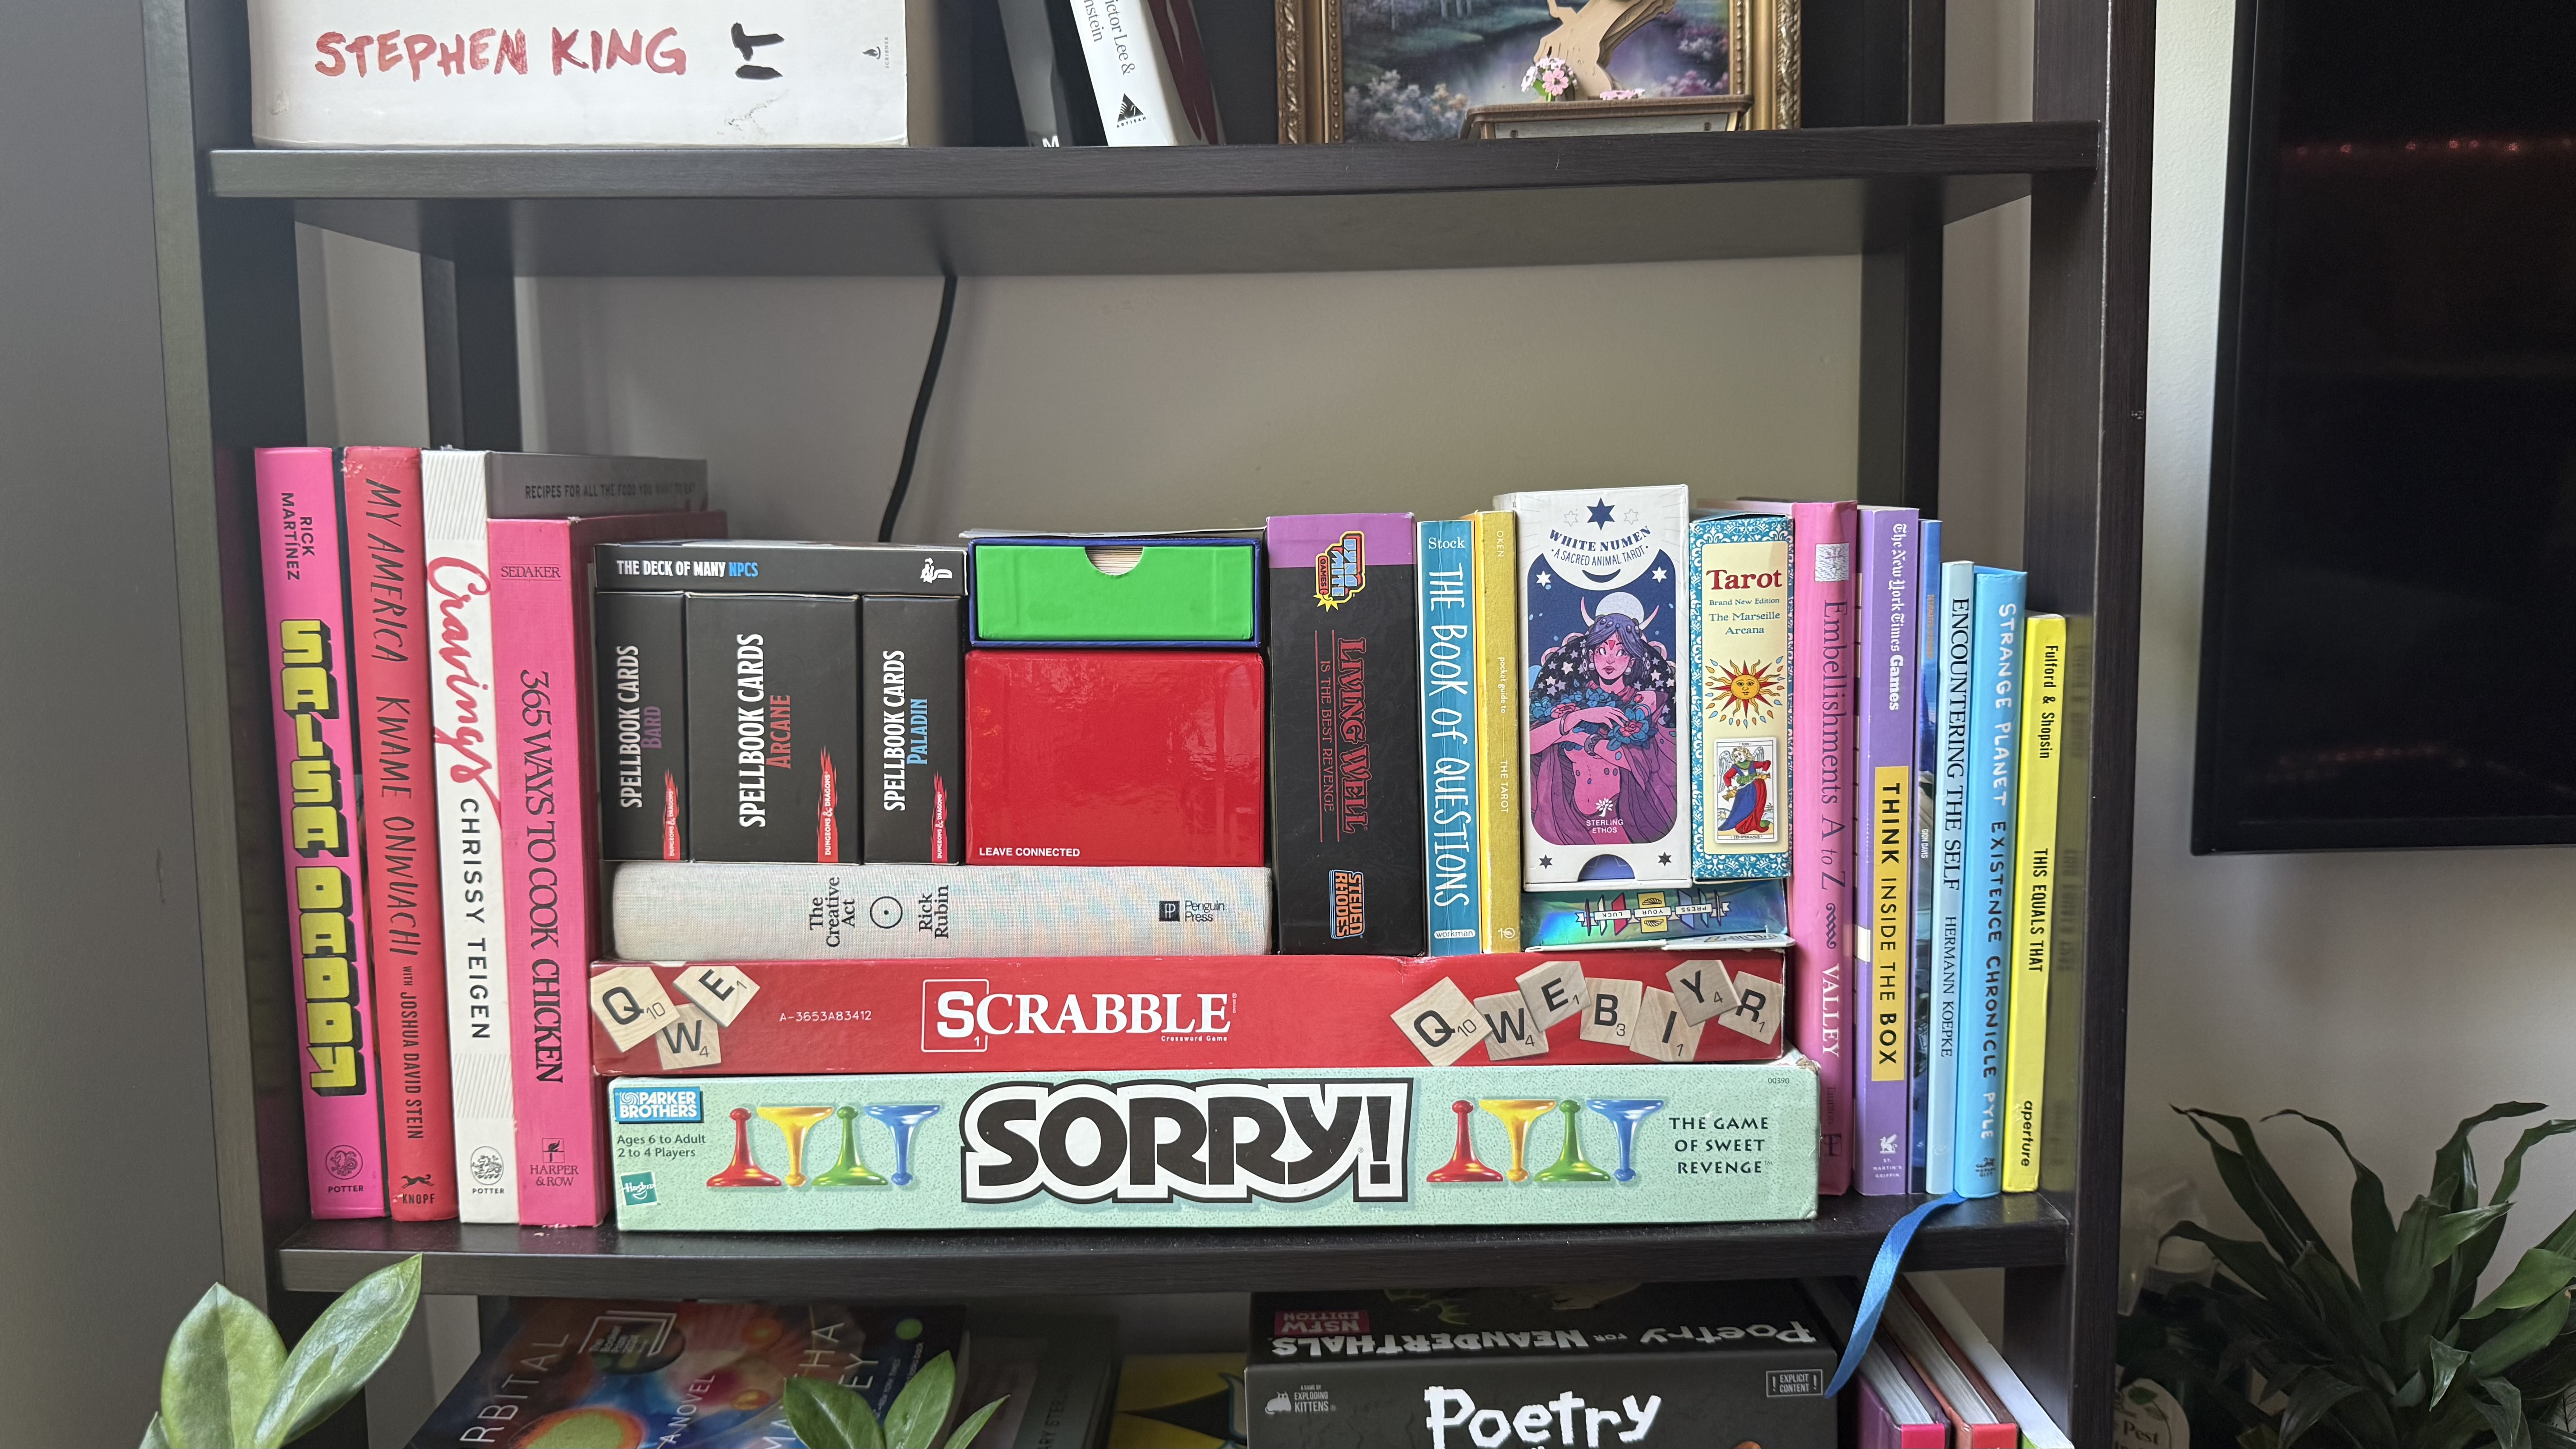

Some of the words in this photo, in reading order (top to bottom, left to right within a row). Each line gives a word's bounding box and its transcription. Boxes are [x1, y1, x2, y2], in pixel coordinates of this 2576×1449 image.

[316, 28, 528, 80] STEPHEN
[552, 27, 686, 76] KING
[731, 23, 784, 79] IT
[1117, 116, 1146, 128] ARTISAN
[366, 478, 401, 528] MY
[526, 486, 561, 499] RECIPES
[565, 485, 580, 497] FOR
[281, 492, 300, 581] MARTÍNEZ
[301, 516, 315, 557] RICK
[1428, 536, 1465, 550] Stock
[1550, 529, 1596, 551] WHITE
[1600, 526, 1651, 552] NUMEN
[1560, 551, 1590, 566] SACRED
[1592, 554, 1621, 566] ANIMAL
[1622, 545, 1645, 562] TAROT
[1892, 524, 1907, 549] The
[501, 566, 560, 579] SEDAKER
[617, 560, 639, 575] THE
[642, 561, 672, 576] DECK
[676, 561, 690, 576] OF
[693, 561, 726, 577] MANY
[729, 561, 758, 577] NPCS
[1706, 570, 1782, 590] Tarot
[1891, 550, 1906, 577] New
[367, 533, 408, 662] AMERICA
[1428, 563, 1464, 612] THE
[1888, 580, 1905, 612] York
[1709, 613, 1729, 621] The
[1732, 612, 1780, 621] Marseille
[1890, 613, 1905, 651] Times
[616, 645, 639, 704] CARDS
[737, 634, 764, 704] CARDS
[1321, 661, 1331, 672] IS
[1429, 624, 1467, 697] BOOK
[1996, 603, 2017, 709] STRANGE
[2043, 645, 2058, 688] Fulford
[427, 557, 501, 828] Cravings
[520, 669, 550, 728] 365
[1321, 678, 1331, 704] THE
[1337, 638, 1366, 747] LIVING
[1821, 600, 1847, 805] Embellishments
[1889, 654, 1904, 711] Games
[1946, 598, 1969, 778] ENCOUNTERING
[641, 705, 662, 750] BARD
[766, 695, 791, 769] ARCANE
[906, 698, 928, 765] PALADIN
[1322, 709, 1332, 742] BEST
[1500, 705, 1506, 713] to
[281, 619, 348, 858] SALSA
[376, 695, 412, 799] KWAME
[618, 707, 642, 808] SPELLBOOK
[2039, 711, 2056, 759] Shopsin
[522, 733, 555, 815] WAYS
[738, 707, 766, 827] SPELLBOOK
[1323, 748, 1334, 811] REVENGE
[1994, 722, 2009, 807] PLANET
[823, 805, 833, 817] &
[1340, 745, 1371, 834] WELL
[1946, 786, 1963, 830] THE
[526, 818, 556, 863] TO
[1433, 757, 1472, 907] QUESTIONS
[1880, 782, 1901, 865] THINK
[459, 798, 484, 923] CHRISSY
[979, 847, 1012, 856] LEAVE
[1015, 848, 1080, 857] CONNECTED
[1943, 840, 1961, 891] SELF
[2034, 848, 2048, 877] THIS
[383, 817, 421, 956] ONWUACHI
[1336, 872, 1348, 936] RHODES
[1350, 874, 1362, 934] STEVEN
[1987, 821, 2006, 943] EXISTENCE
[527, 868, 559, 949] COOK
[810, 897, 824, 931] The
[825, 877, 840, 948] Creative
[842, 900, 855, 928] Act
[919, 893, 932, 932] Rick
[934, 885, 948, 938] Rubin
[1185, 901, 1224, 913] Penguin
[1185, 911, 1213, 922] Press
[1881, 878, 1896, 951] INSIDE
[2030, 885, 2047, 936] EQUALS
[403, 966, 412, 985] WITH
[1943, 916, 1956, 994] HERMANN
[2029, 940, 2043, 972] THAT
[295, 865, 367, 1097] DADDY
[467, 938, 491, 1038] TEIGEN
[1880, 962, 1895, 1000] THE
[401, 992, 418, 1047] JOSHUA
[531, 958, 563, 1083] CHICKEN
[780, 1010, 872, 1023] A-3653A83412
[937, 991, 1232, 1038] SCRABBLE
[1822, 963, 1840, 1057] VALLEY
[1941, 1001, 1954, 1057] KOEPKE
[1983, 956, 2001, 1078] CHRONICLE
[1879, 1013, 1896, 1065] BOX
[404, 1053, 420, 1093] DAVID
[406, 1099, 423, 1139] STEIN
[621, 1104, 696, 1119] BROTHERS
[639, 1092, 695, 1105] PARKER
[1981, 1092, 1996, 1138] PYLE
[617, 1135, 645, 1145] Ages
[648, 1135, 655, 1144] 6
[675, 1134, 706, 1144] Adult
[970, 1089, 1400, 1194] SORRY!
[1670, 1117, 1705, 1131] THE
[1711, 1116, 1769, 1129] GAME
[1674, 1138, 1699, 1152] OF
[1707, 1138, 1763, 1151] SWEET
[2020, 1100, 2033, 1167] aperture
[328, 1185, 363, 1193] POTTER
[530, 1165, 579, 1175] HARPER
[1678, 1160, 1762, 1174] REVENGE
[402, 1194, 435, 1204] KNOPF
[1282, 1320, 1359, 1334] NSFW
[1283, 1311, 1359, 1320] EDITION
[1640, 1322, 1817, 1343] Poetry
[1273, 1329, 1590, 1356] NEANDERTHALS
[1780, 1374, 1809, 1382] EXPLICIT
[1780, 1383, 1809, 1393] CONTENT
[668, 1375, 716, 1430] NOVEL
[1294, 1401, 1329, 1412] KITTENS
[1424, 1386, 1662, 1449] Poetry
